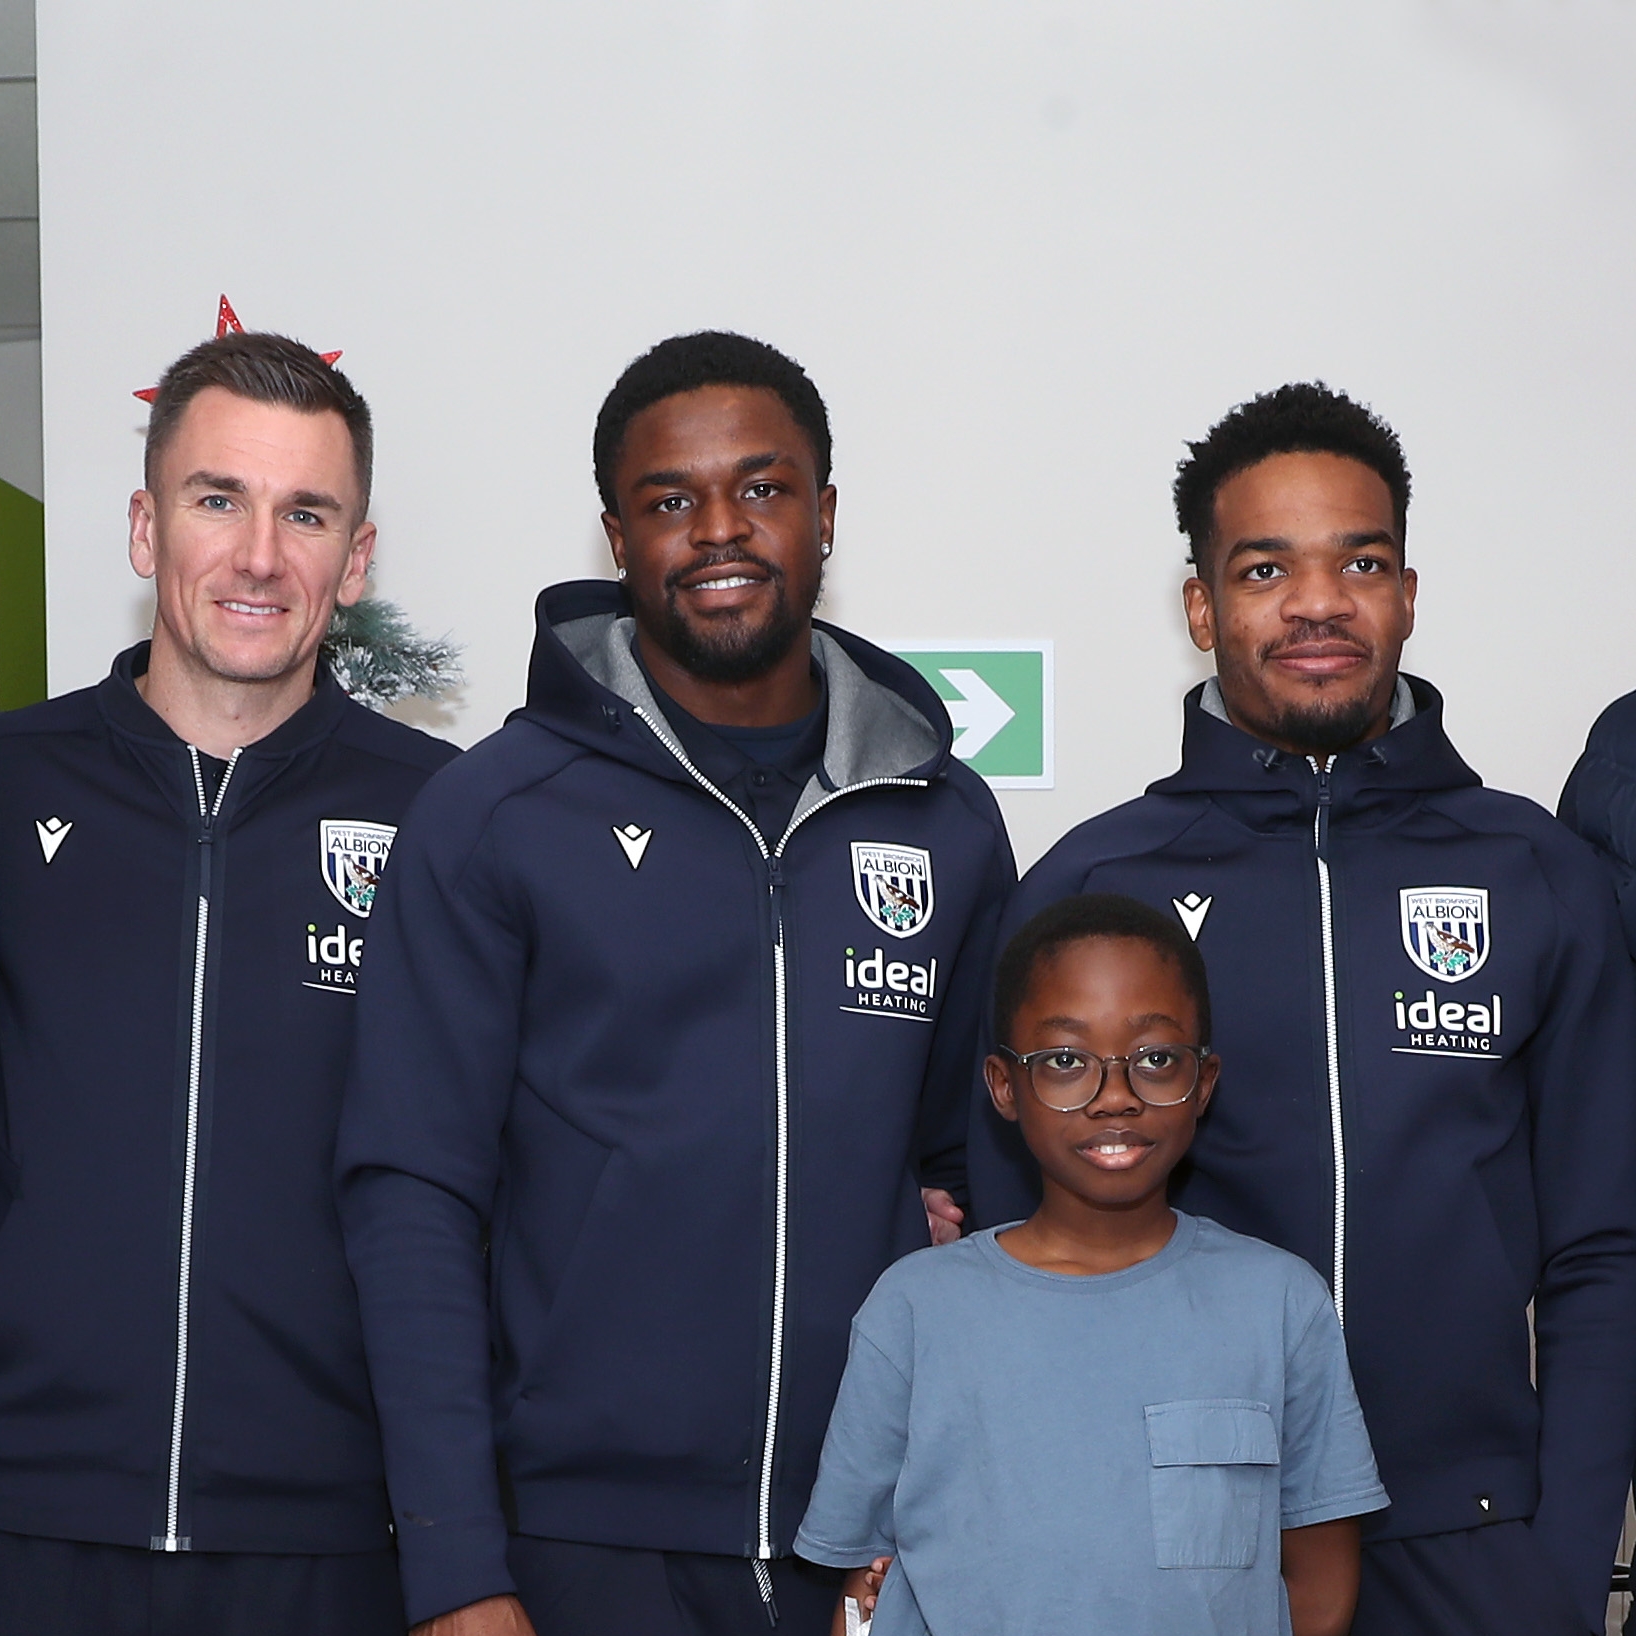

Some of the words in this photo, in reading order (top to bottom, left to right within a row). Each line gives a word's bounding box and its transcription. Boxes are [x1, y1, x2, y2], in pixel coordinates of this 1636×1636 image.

[331, 837, 391, 855] ALBION
[862, 858, 923, 877] ALBION
[1412, 905, 1479, 919] ALBION
[845, 947, 937, 998] ideal
[858, 992, 927, 1013] HEATING
[1395, 990, 1501, 1036] ideal
[1410, 1033, 1490, 1051] HEATING
